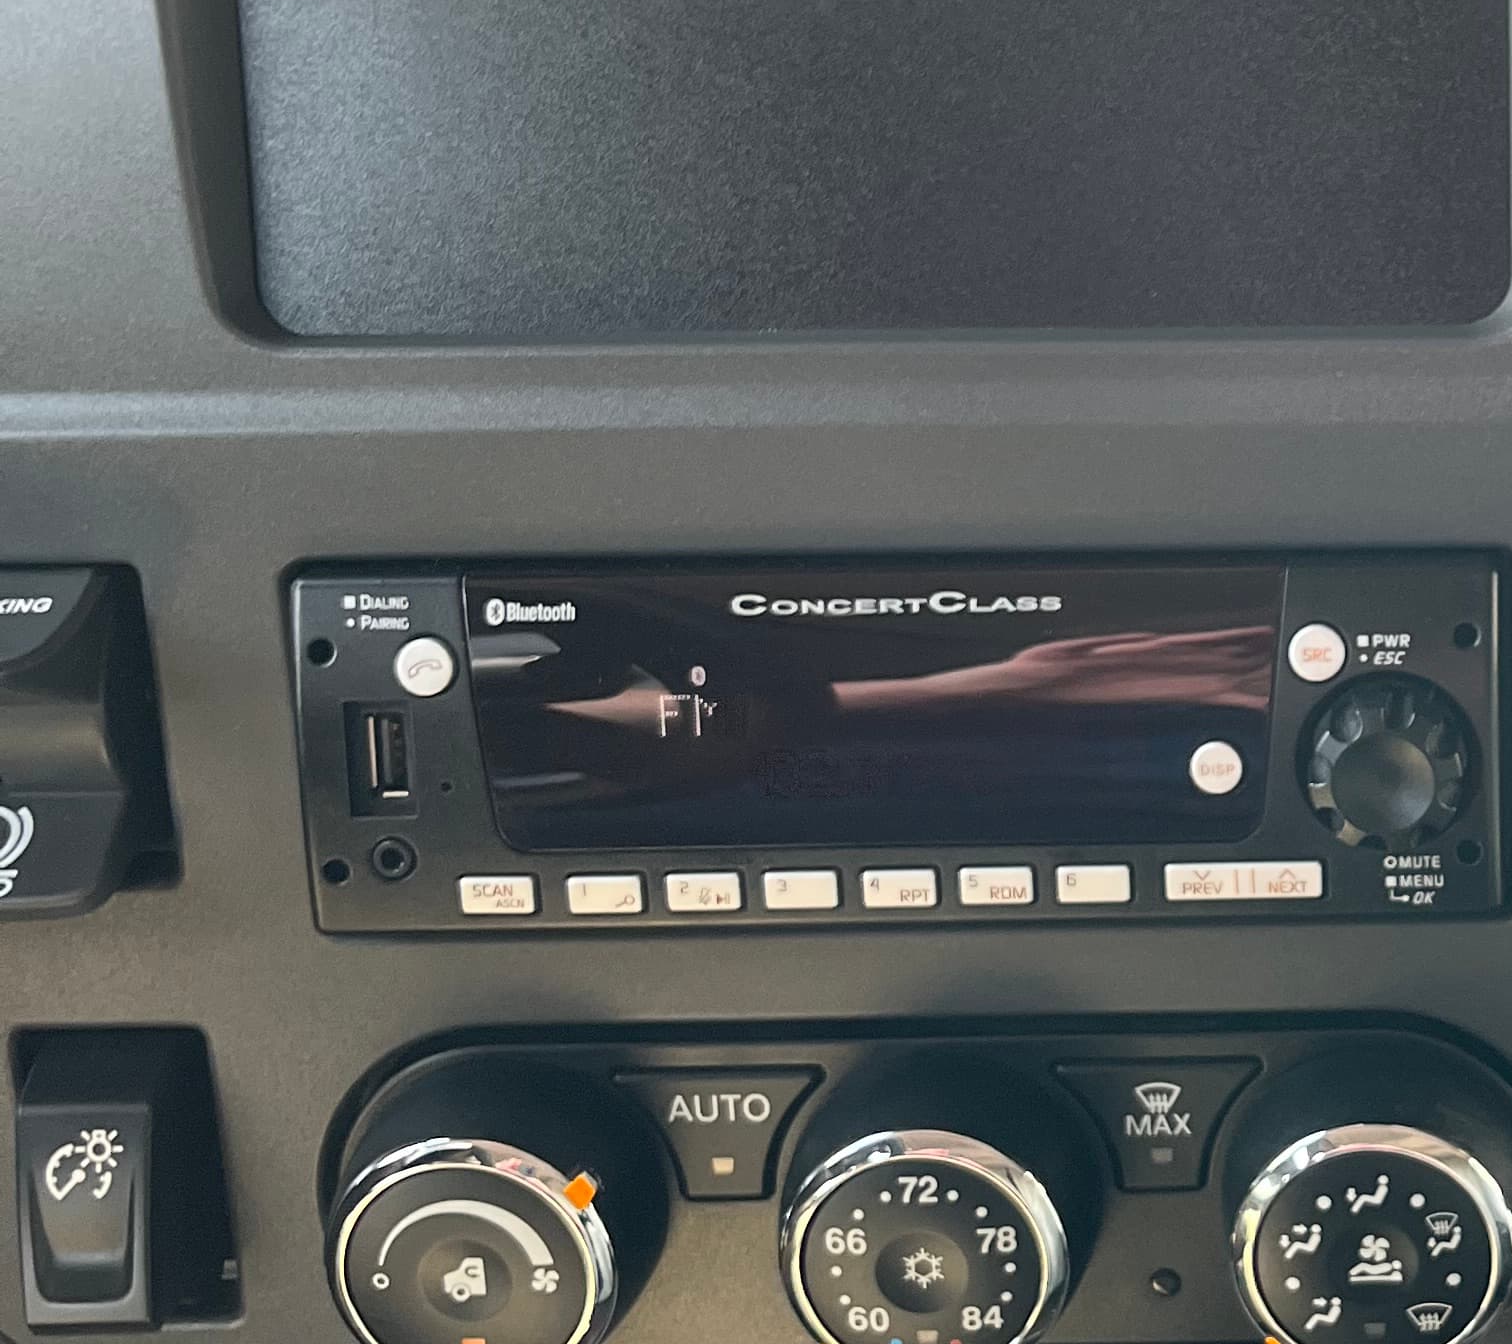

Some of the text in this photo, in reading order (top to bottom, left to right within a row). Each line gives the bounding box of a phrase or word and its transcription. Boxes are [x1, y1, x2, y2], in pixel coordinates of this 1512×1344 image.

[359, 594, 409, 610] DIALING
[505, 601, 576, 623] Bluetooth
[360, 614, 410, 630] PAIRING
[1372, 633, 1411, 648] PWR
[1303, 647, 1332, 662] SRC
[1373, 651, 1406, 665] ESC
[1200, 763, 1235, 776] DISP
[1399, 855, 1441, 868] MUTE
[1182, 882, 1224, 894] PREV
[1268, 881, 1309, 893] NEXT
[1399, 874, 1444, 887] MENU
[472, 883, 513, 897] SCAN
[899, 888, 930, 902] RPT
[989, 887, 1028, 900] RDM
[1412, 891, 1436, 904] OK
[668, 1093, 771, 1123] AUTO
[1125, 1113, 1192, 1136] MAX
[898, 1175, 940, 1204] 72
[824, 1228, 867, 1255] 66
[976, 1226, 1018, 1253] 78
[847, 1306, 890, 1332] 60
[961, 1306, 1004, 1331] 84
